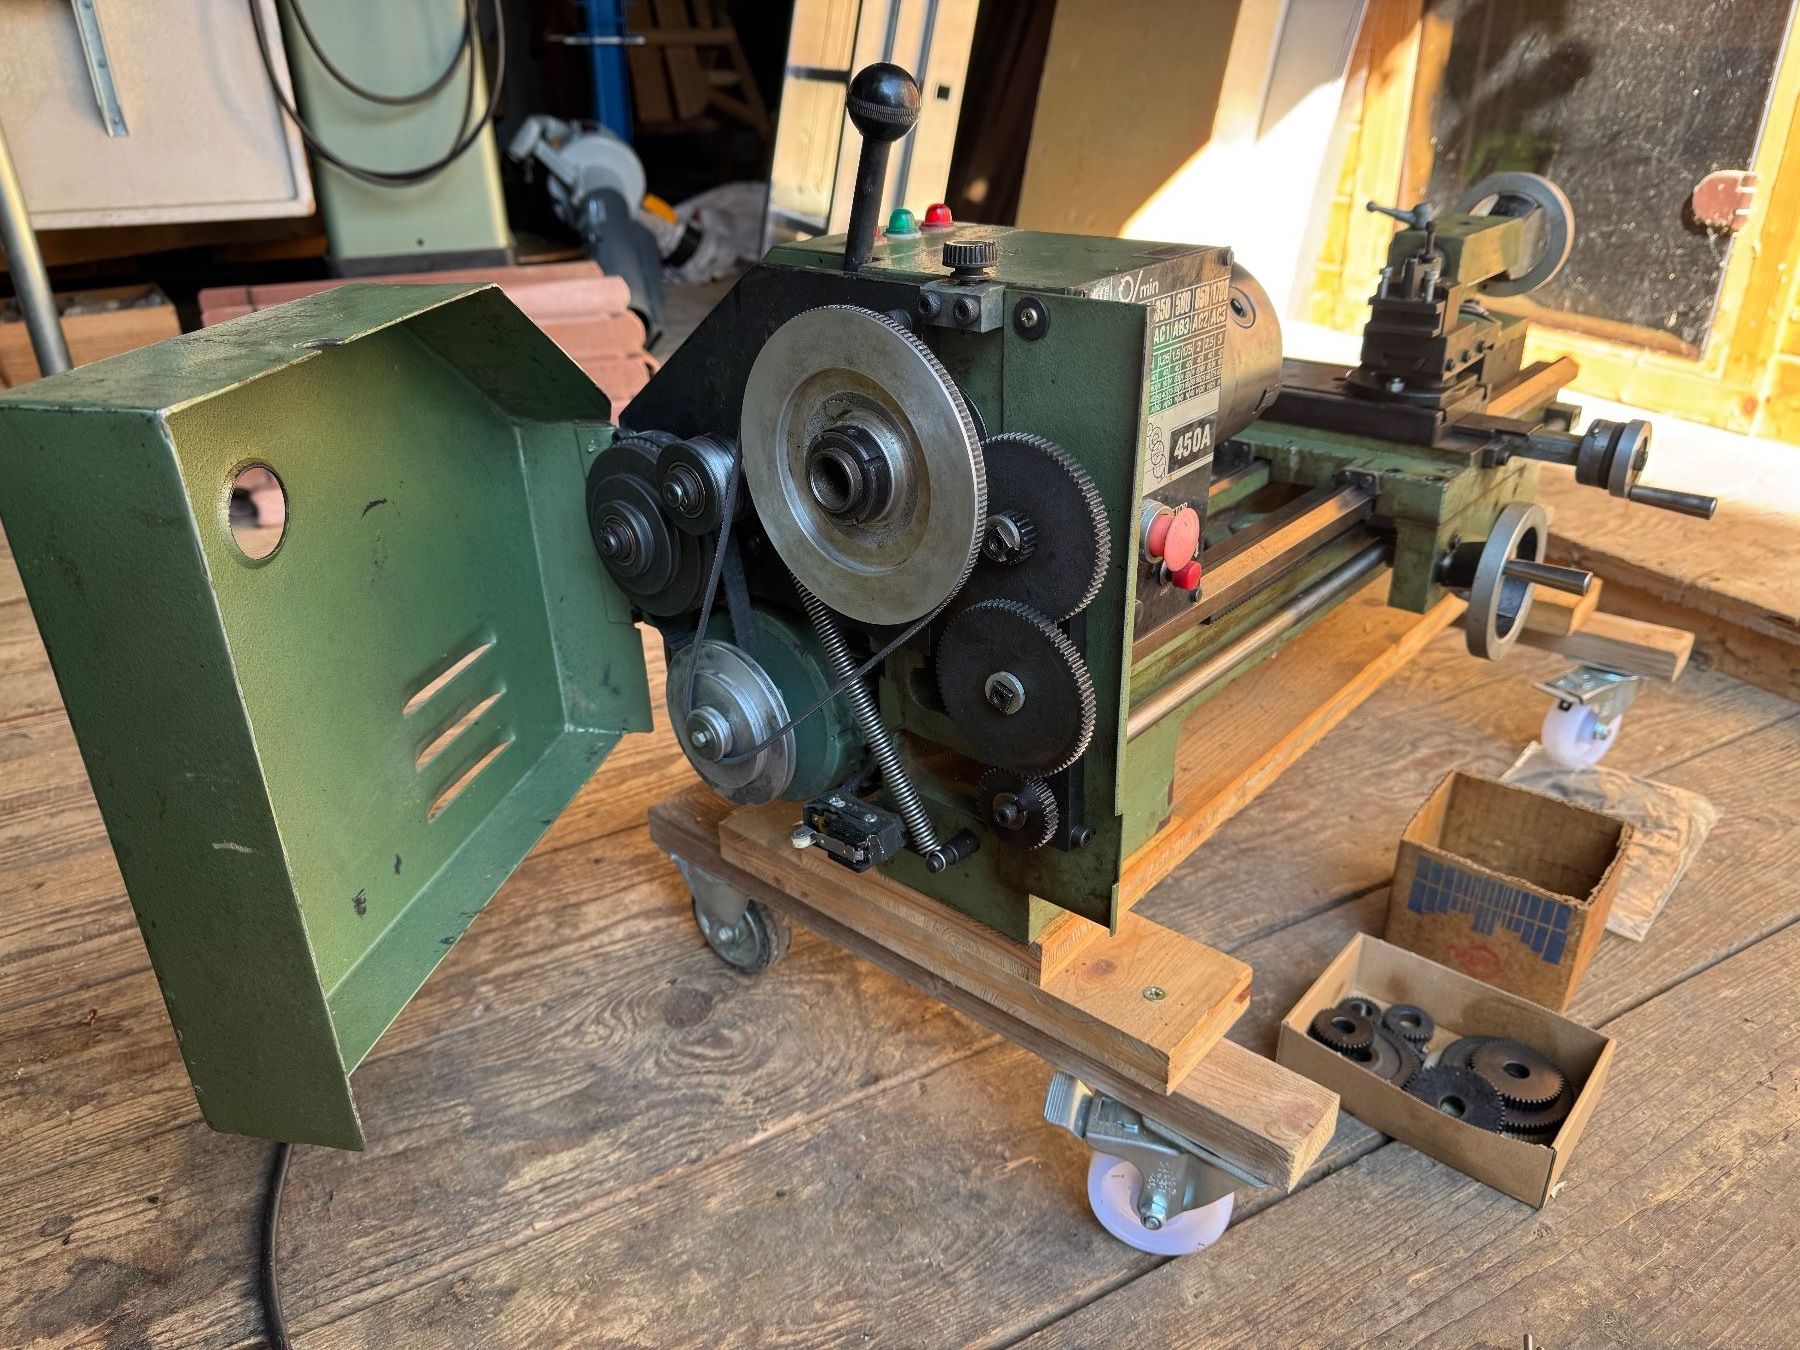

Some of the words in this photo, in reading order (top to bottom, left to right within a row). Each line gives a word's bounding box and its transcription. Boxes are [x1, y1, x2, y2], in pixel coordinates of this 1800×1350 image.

[1154, 325, 1170, 345] AC1
[1173, 317, 1190, 337] AB3
[1192, 312, 1208, 331] AC2
[1210, 305, 1226, 324] AC3
[1196, 341, 1201, 351] 2
[1173, 423, 1211, 460] 450A
